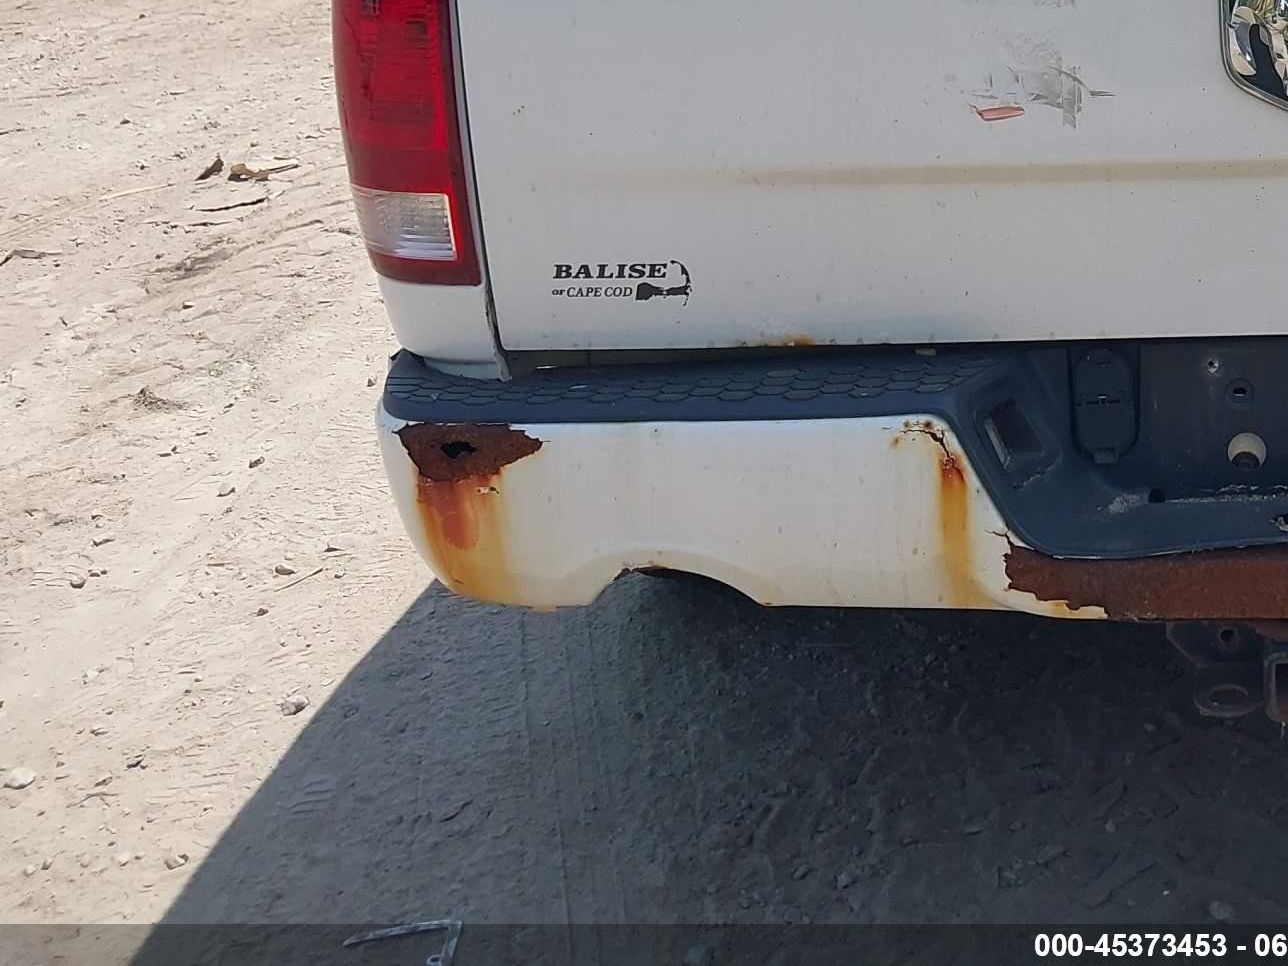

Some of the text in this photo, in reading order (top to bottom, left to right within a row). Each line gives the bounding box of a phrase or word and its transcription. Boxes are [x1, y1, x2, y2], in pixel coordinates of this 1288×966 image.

[552, 263, 668, 279] BALISE
[566, 286, 602, 298] CAPE
[604, 286, 633, 297] COD
